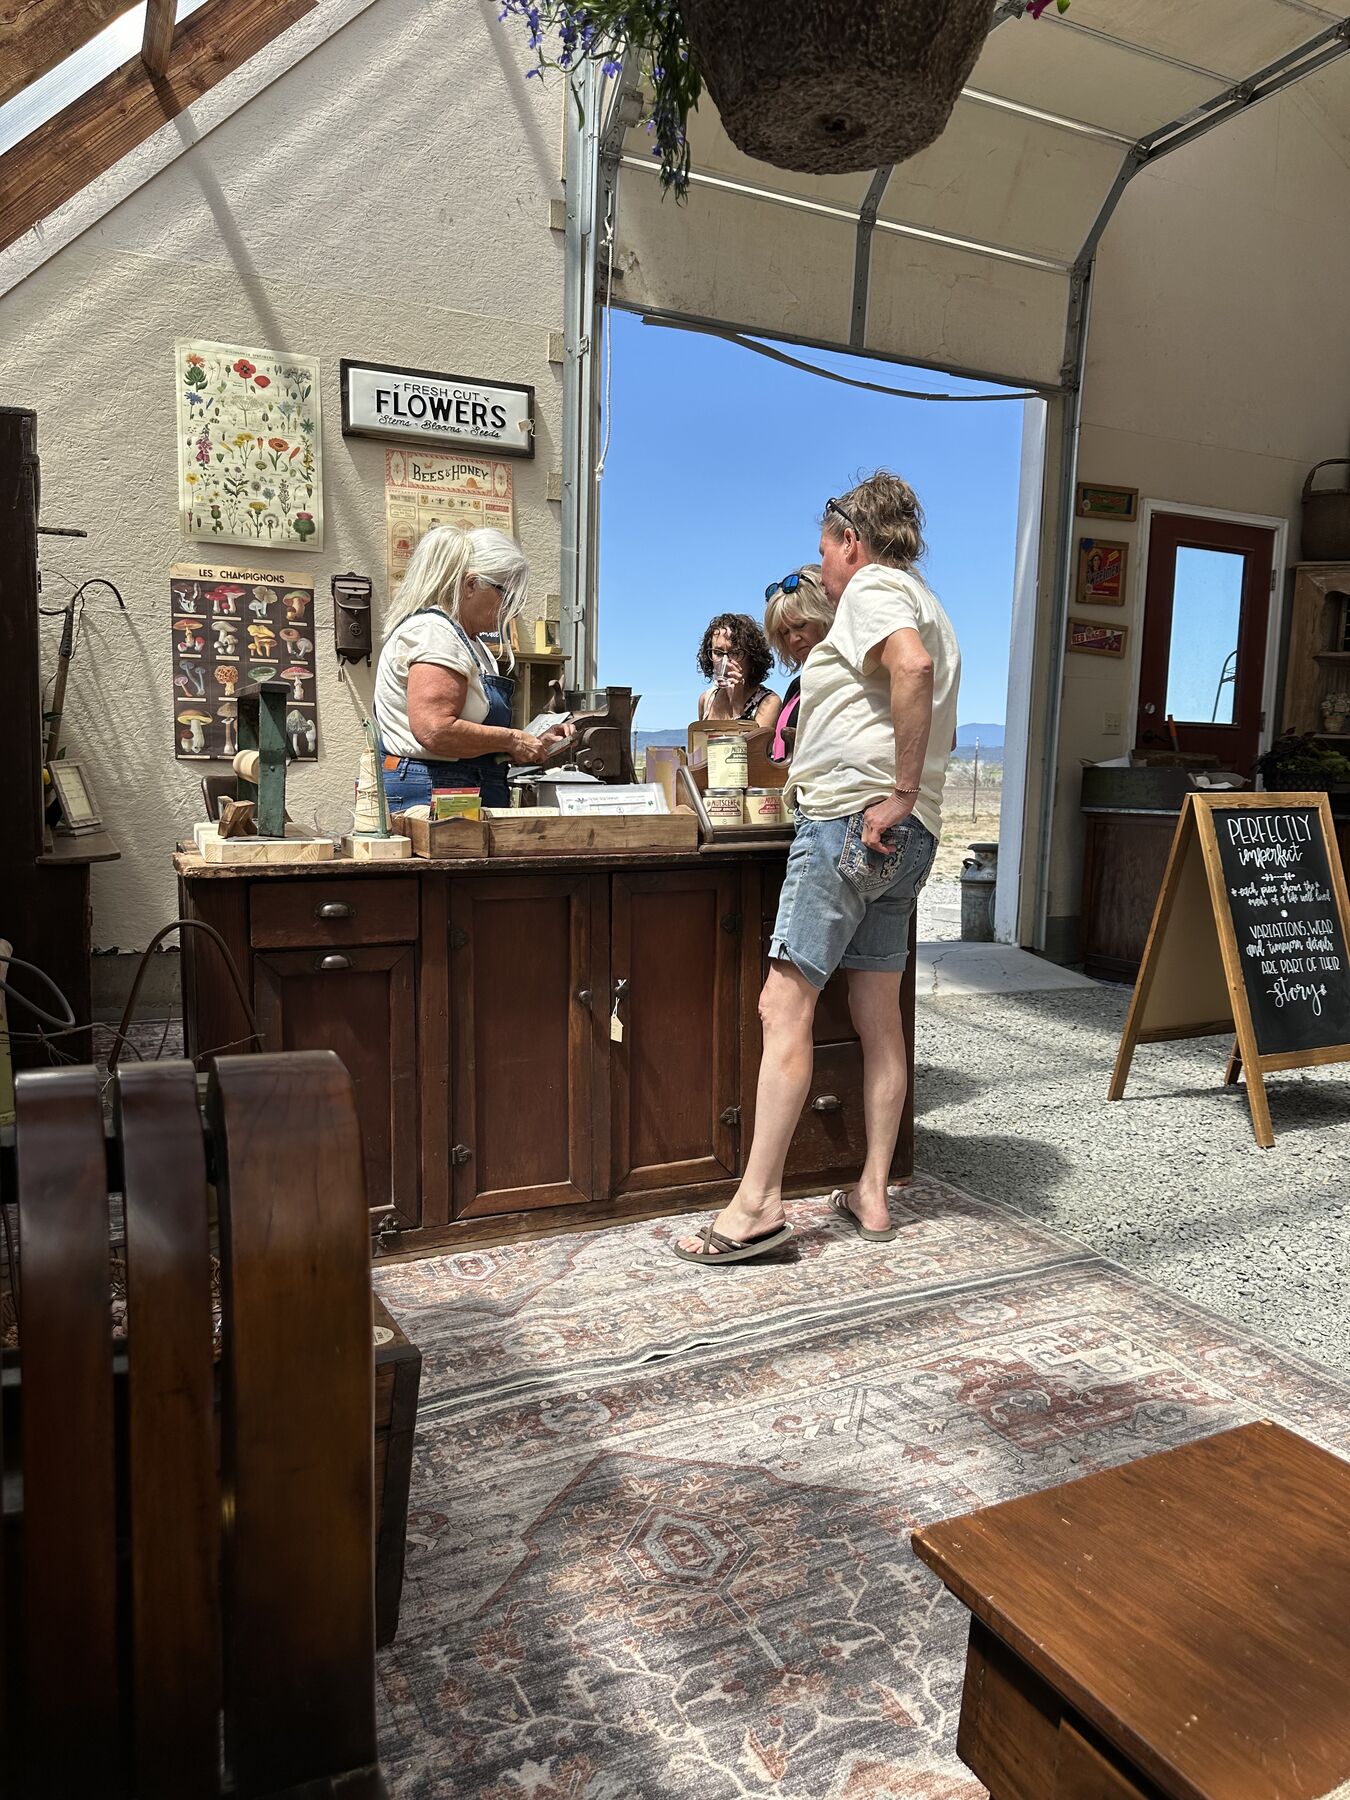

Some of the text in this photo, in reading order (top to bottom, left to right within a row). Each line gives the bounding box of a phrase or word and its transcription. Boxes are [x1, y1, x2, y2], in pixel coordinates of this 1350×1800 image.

[403, 383, 480, 401] FRESH CUT
[376, 389, 506, 429] FLOWERS
[378, 414, 500, 438] Stems Blooms Seeds
[412, 462, 444, 482] BEES
[452, 465, 488, 481] HONEY
[199, 569, 285, 583] LES CHAMPIGNONS
[1227, 815, 1311, 845] PERFECTLY
[1238, 842, 1303, 869] imperfect
[1307, 919, 1334, 935] WEAR
[1261, 956, 1341, 975] ARE PART OF THEIR
[1266, 976, 1323, 1016] story
